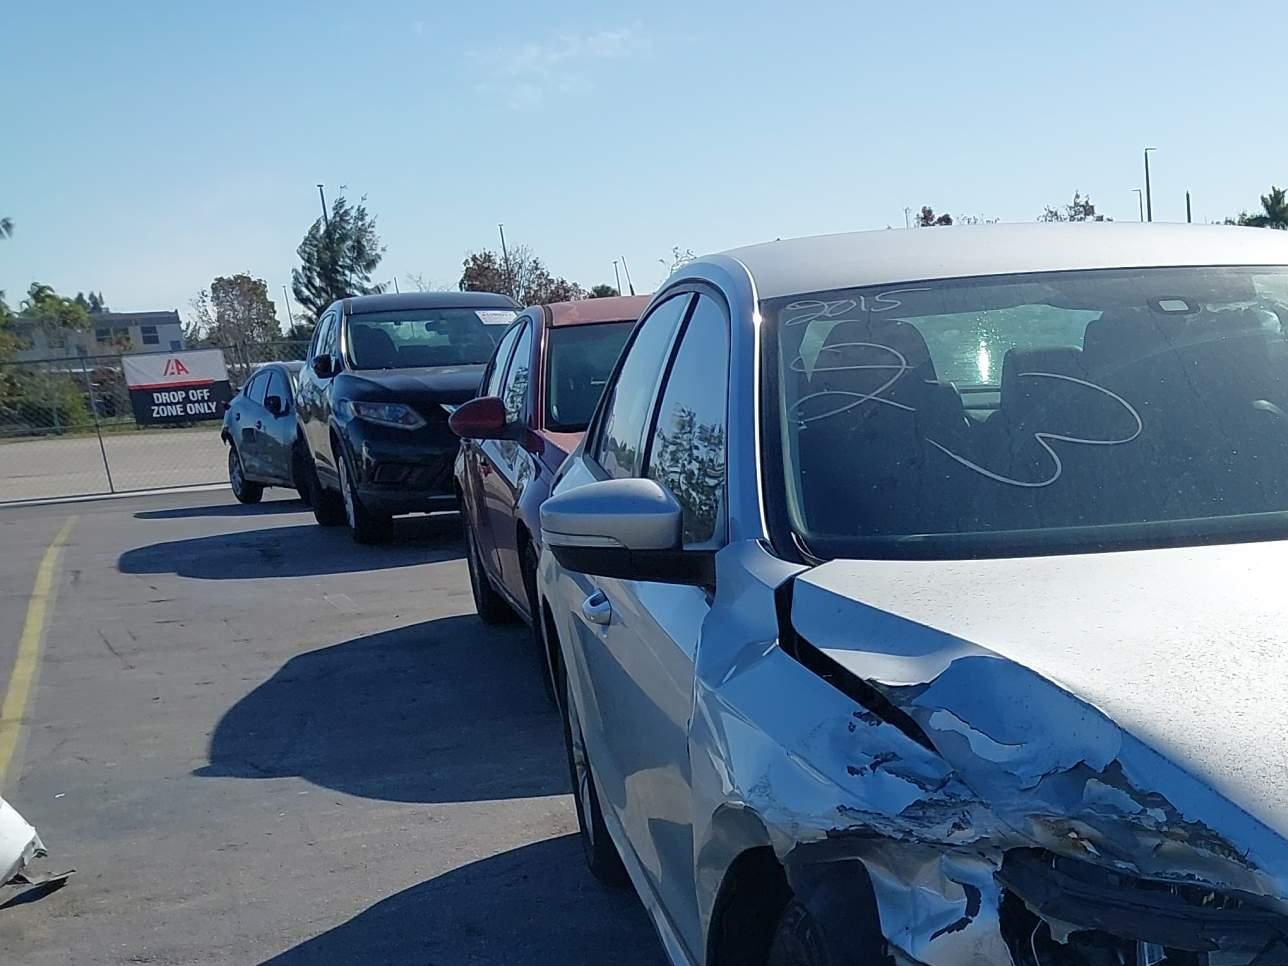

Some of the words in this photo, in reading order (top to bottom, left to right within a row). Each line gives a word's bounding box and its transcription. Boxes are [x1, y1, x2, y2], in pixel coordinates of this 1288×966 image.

[784, 288, 932, 326] 2015
[153, 390, 186, 404] DROP
[188, 388, 211, 402] OFF
[151, 404, 185, 418] ZONE
[186, 401, 217, 415] ONLY
